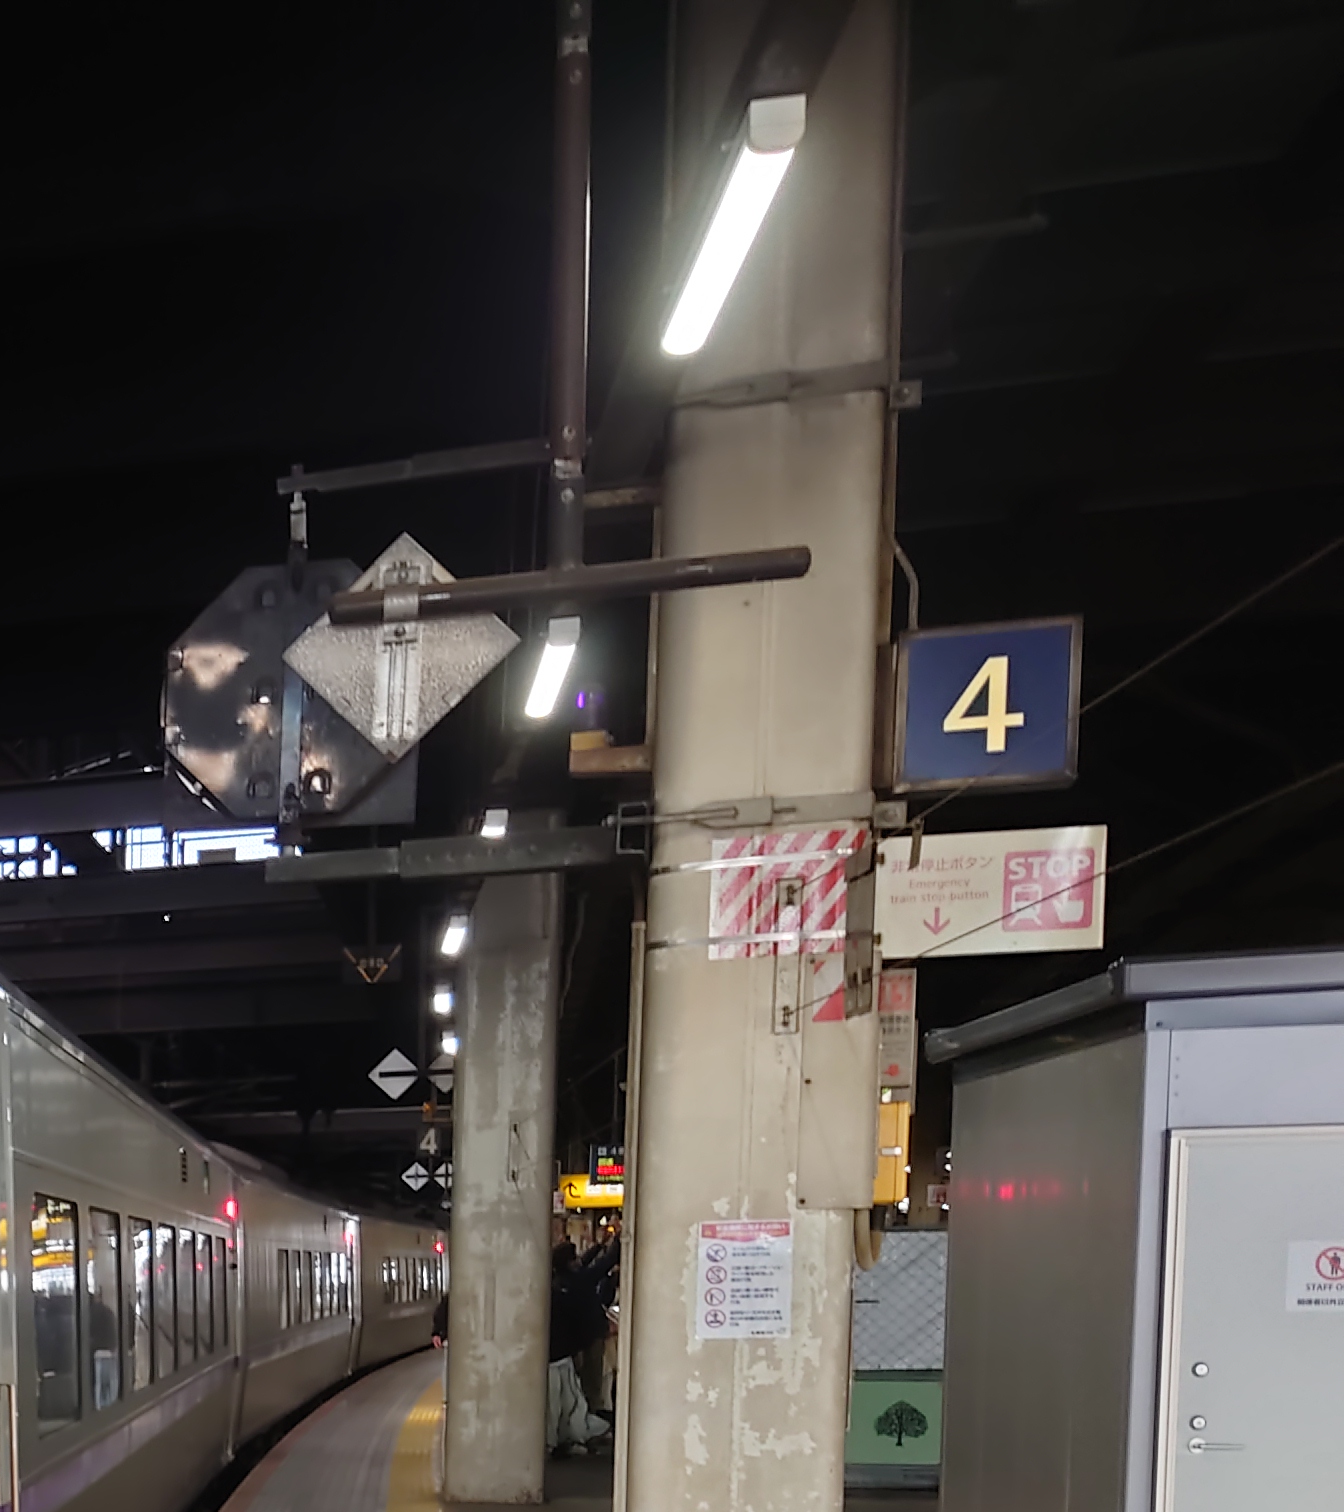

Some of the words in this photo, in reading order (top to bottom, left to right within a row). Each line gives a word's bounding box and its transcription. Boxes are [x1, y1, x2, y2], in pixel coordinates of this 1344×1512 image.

[942, 654, 1025, 753] 4
[891, 856, 994, 874] 非停止ボタン
[1008, 854, 1091, 880] STOP
[908, 878, 971, 890] Emergency
[890, 894, 917, 904] train
[921, 893, 946, 903] stop
[949, 890, 990, 902] button
[419, 1127, 439, 1155] 4
[1305, 1282, 1333, 1292] STAFF
